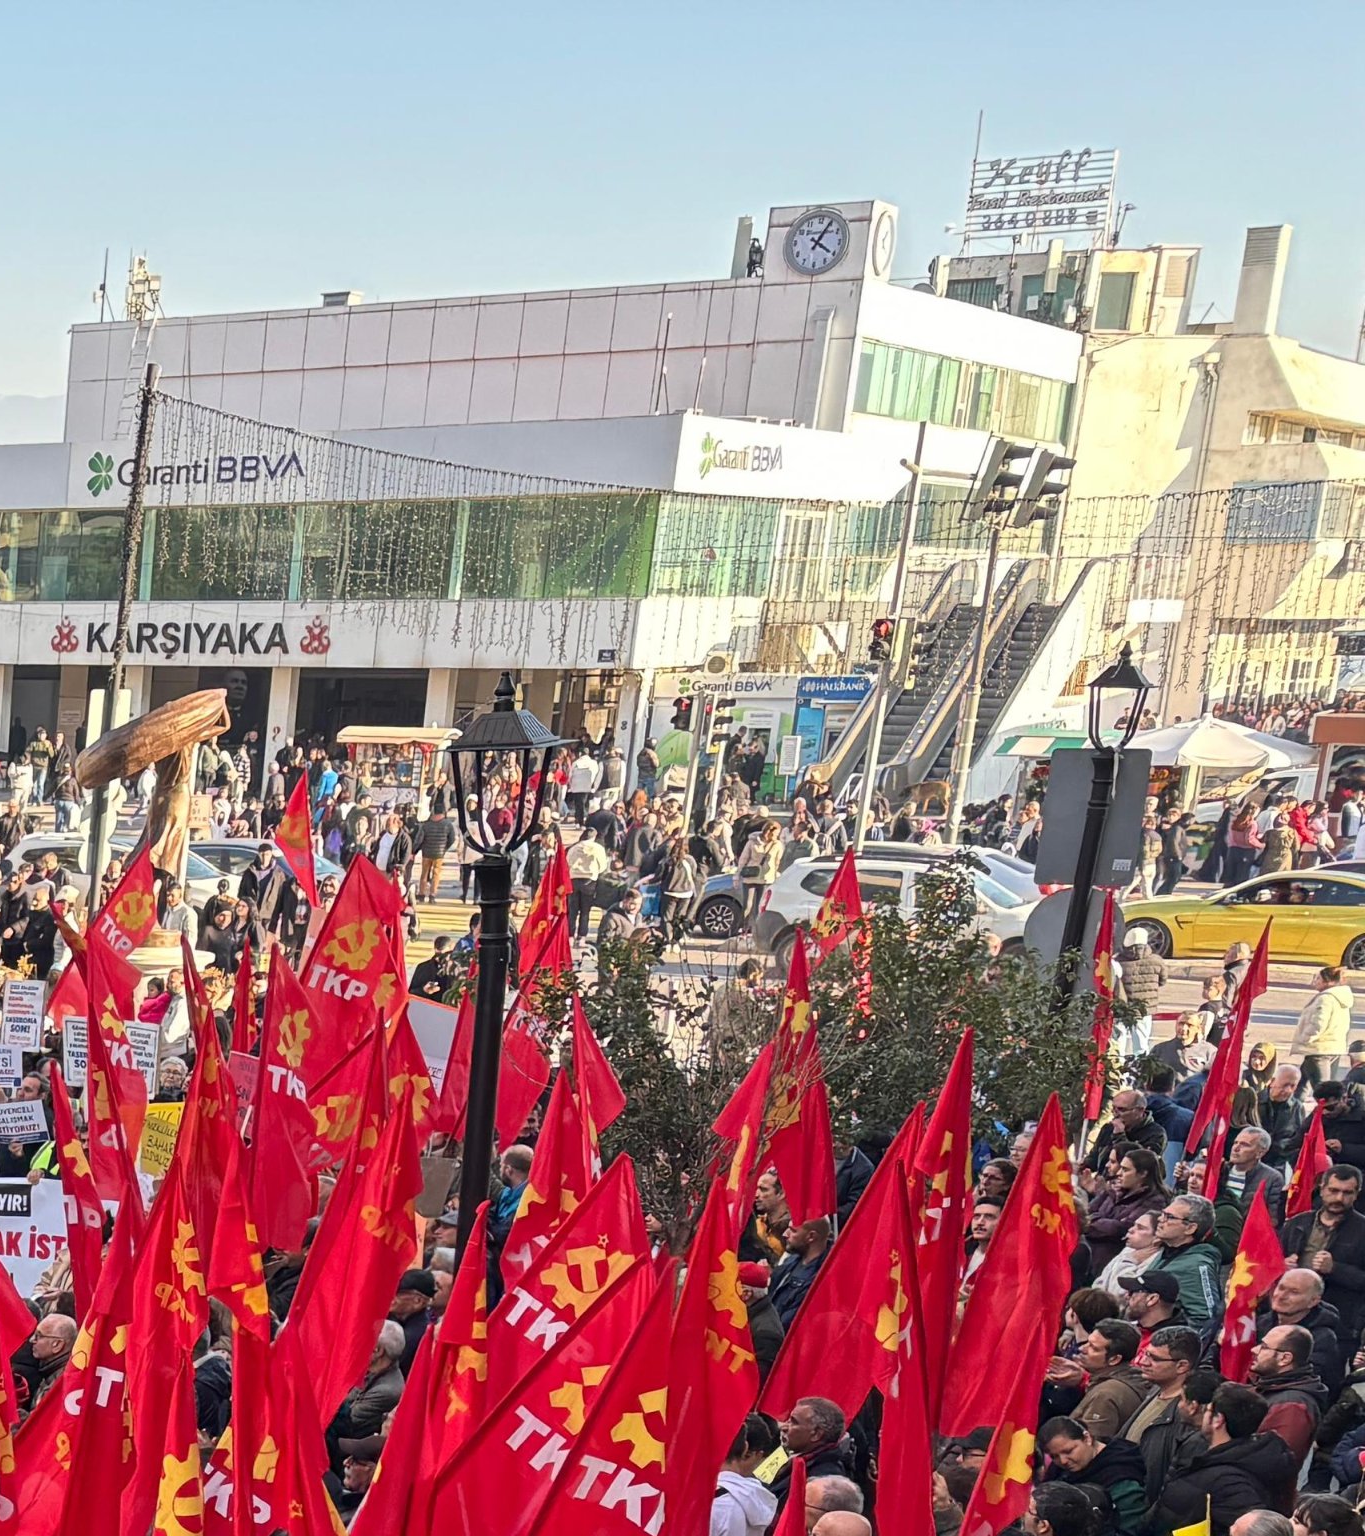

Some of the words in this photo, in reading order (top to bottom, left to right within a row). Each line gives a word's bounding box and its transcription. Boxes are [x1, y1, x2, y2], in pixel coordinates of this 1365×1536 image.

[216, 450, 305, 484] BBVA
[86, 622, 290, 660] KARŞIYAKA
[691, 679, 732, 693] Garanti
[734, 681, 773, 692] BBVA
[307, 963, 368, 1001] TKP
[503, 1286, 569, 1352] TK
[505, 1405, 571, 1482] TK
